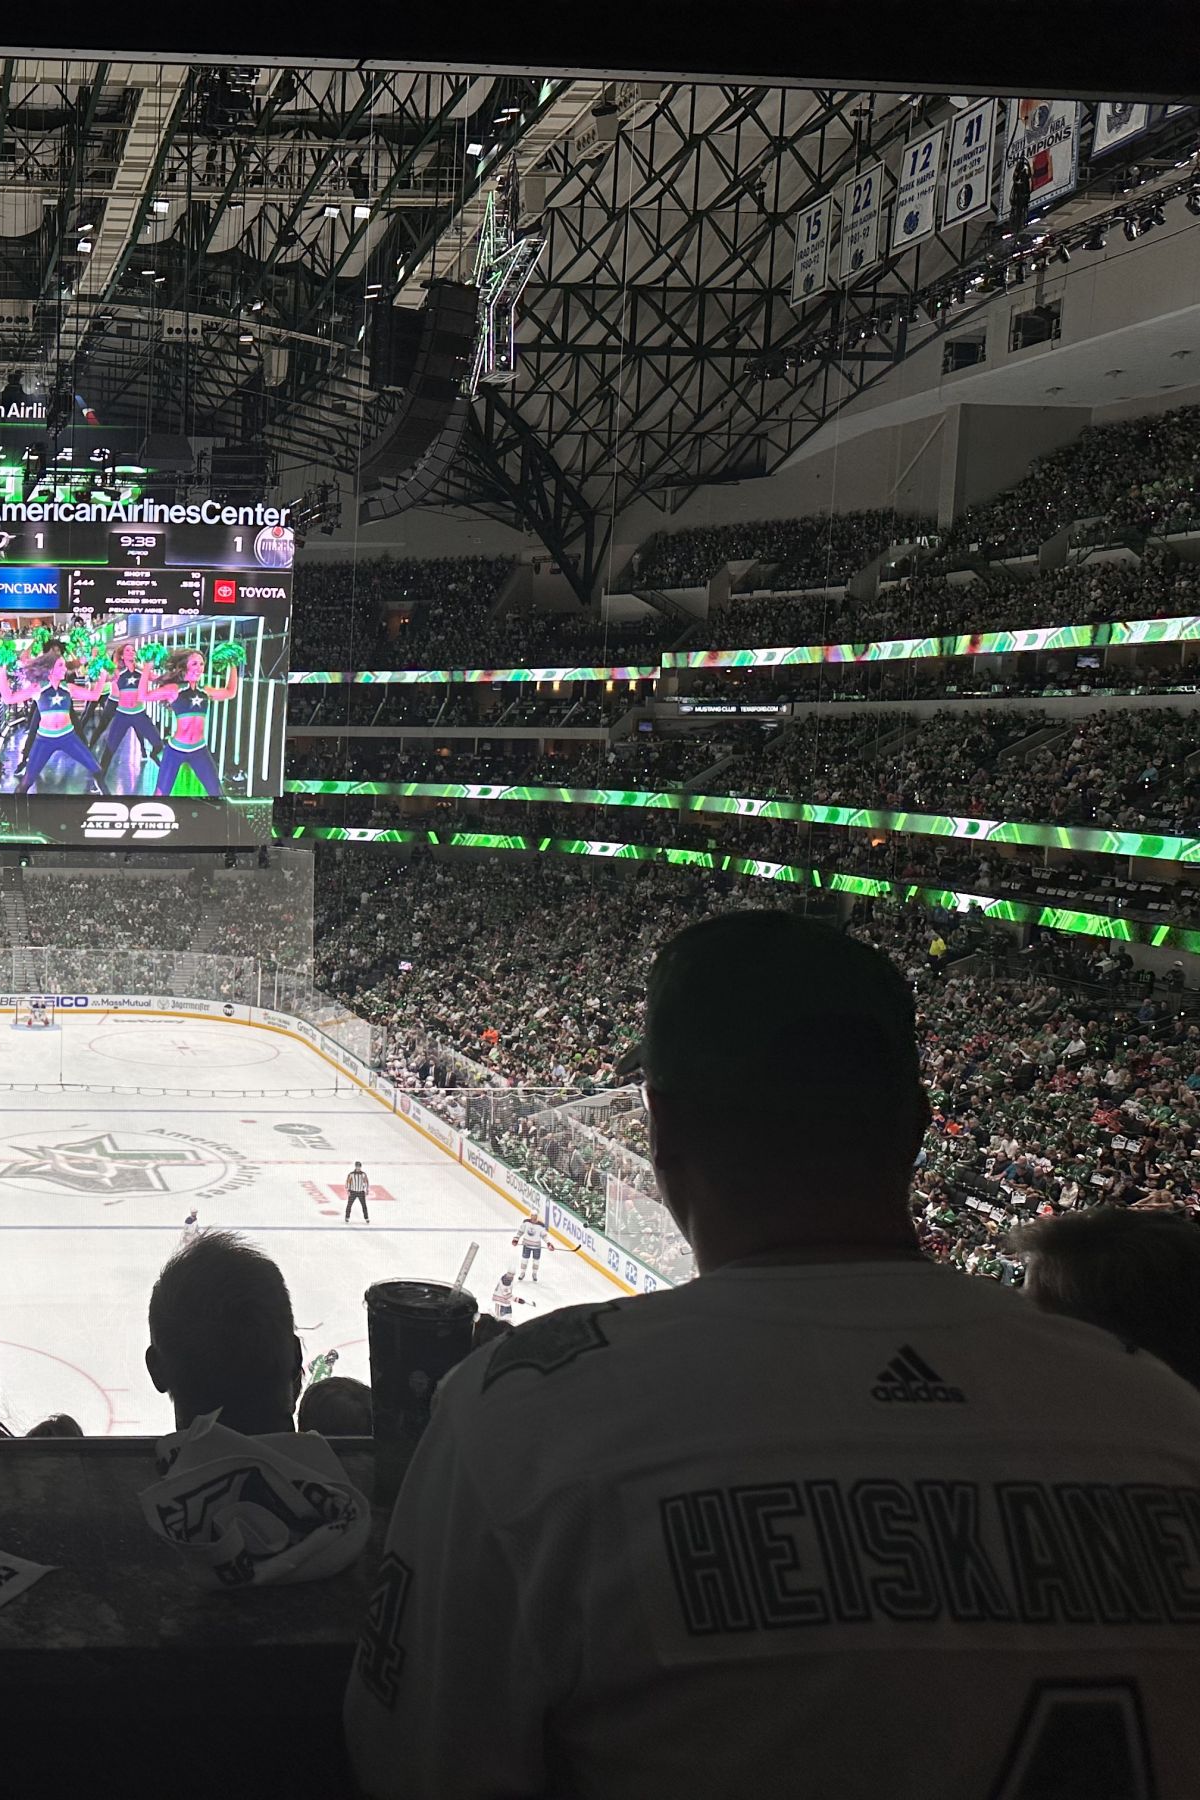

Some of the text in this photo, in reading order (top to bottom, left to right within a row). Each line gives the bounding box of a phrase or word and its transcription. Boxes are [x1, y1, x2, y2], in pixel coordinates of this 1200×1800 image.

[962, 114, 983, 148] 41
[1050, 116, 1066, 134] NBA
[910, 142, 933, 177] 12
[1007, 126, 1072, 168] CHAMPIONS
[916, 169, 936, 186] HARPER
[852, 177, 873, 215] 22
[806, 209, 822, 243] 15
[34, 533, 44, 549] 1
[120, 536, 157, 548] 9:38
[233, 536, 243, 553] 1
[135, 556, 141, 566] 1
[238, 586, 287, 599] TOYOTA
[694, 705, 721, 713] MUSTANG
[80, 821, 180, 830] JAKE OETTINGER
[84, 801, 176, 839] 29
[101, 998, 152, 1008] MassMutual
[146, 1127, 249, 1161] American
[467, 1149, 494, 1178] verizon
[195, 1164, 262, 1200] Airlines
[561, 1218, 597, 1253] FANDUEL
[869, 1380, 966, 1404] adidas
[659, 1478, 1200, 1635] HEISKANE
